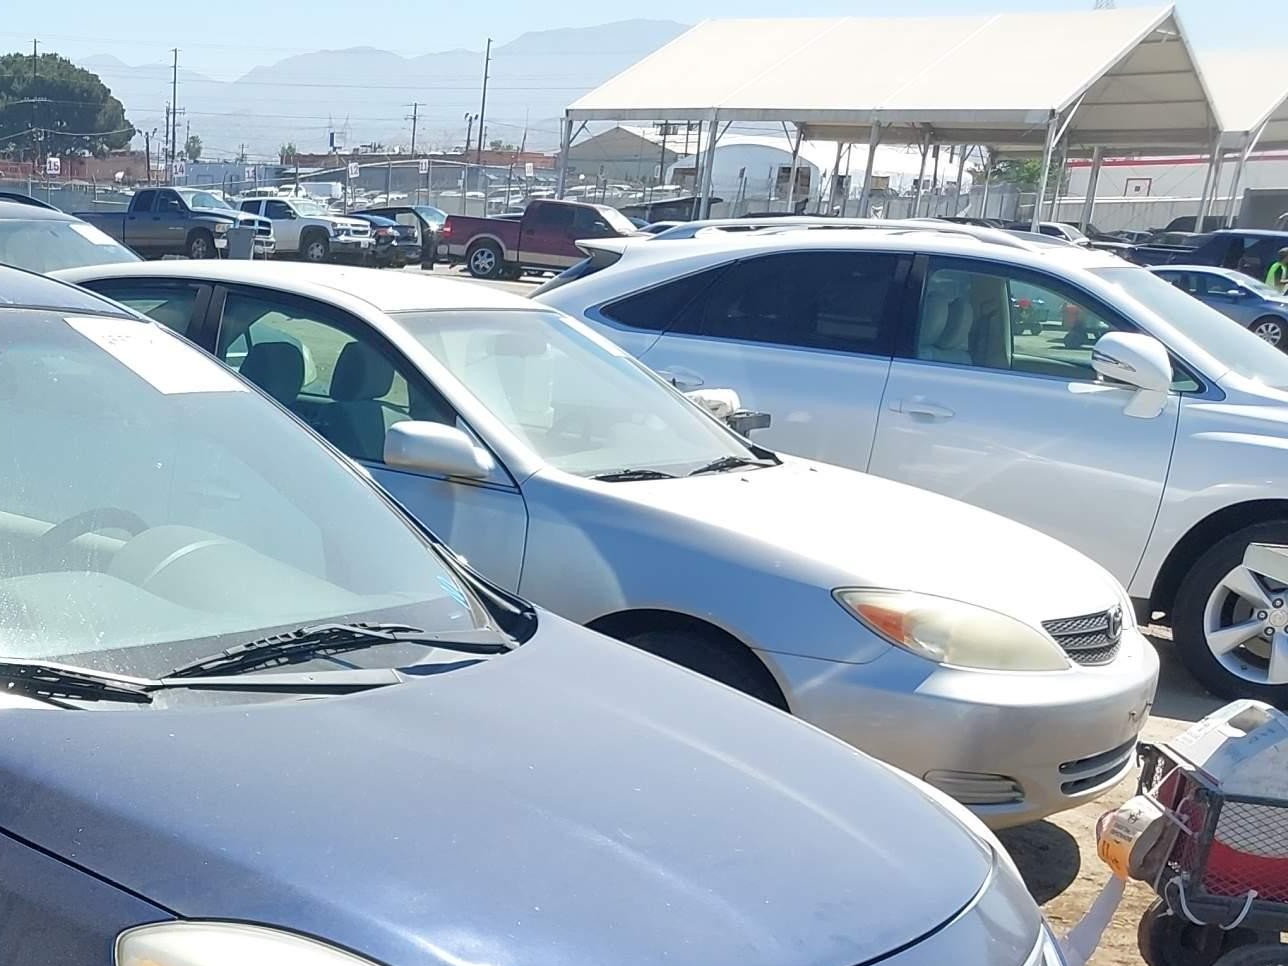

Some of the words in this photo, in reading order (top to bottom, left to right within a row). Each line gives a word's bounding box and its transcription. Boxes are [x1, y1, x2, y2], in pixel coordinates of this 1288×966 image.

[47, 160, 59, 171] 15
[173, 163, 184, 175] 14
[349, 164, 359, 175] 12
